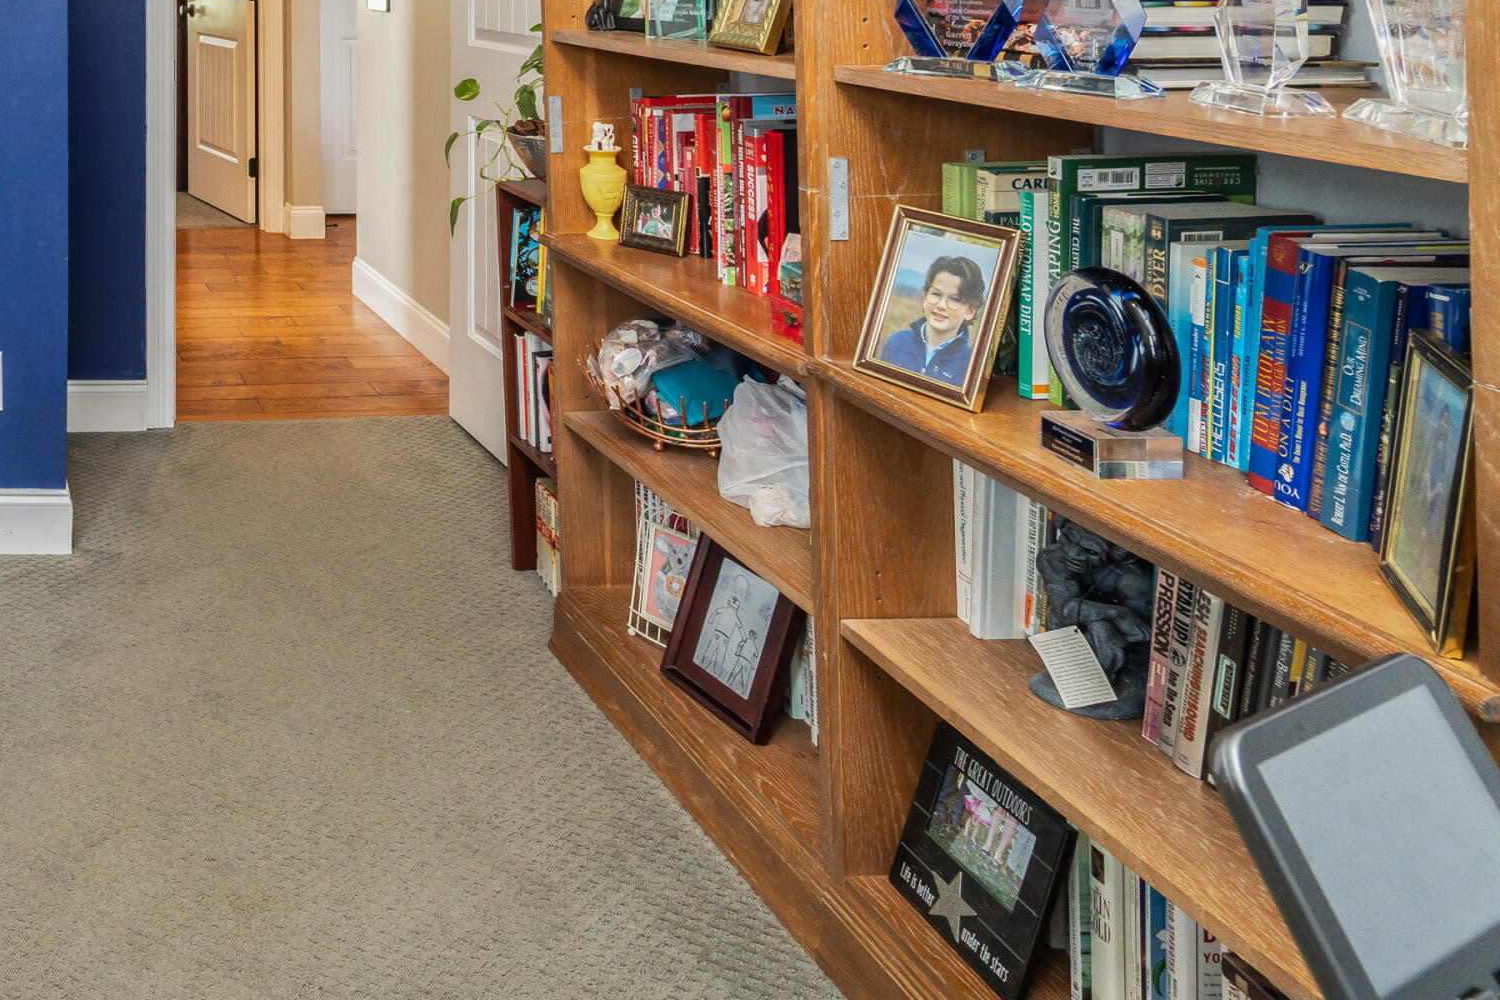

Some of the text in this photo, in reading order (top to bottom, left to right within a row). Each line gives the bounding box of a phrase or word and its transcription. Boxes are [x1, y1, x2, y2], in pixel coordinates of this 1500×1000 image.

[946, 31, 972, 39] Garrett
[747, 164, 755, 220] SUCCESS
[1071, 218, 1080, 270] THE CELESTI
[1021, 249, 1031, 302] FODMAP
[1152, 248, 1166, 299] DYER
[1020, 304, 1031, 335] DIET
[1191, 327, 1199, 352] Leader
[1273, 318, 1287, 379] GENERATION
[1342, 357, 1355, 376] OUR
[1231, 353, 1240, 388] NEXT!
[1253, 314, 1276, 445] TOM BROKAW
[1324, 365, 1336, 401] AMERICA
[1349, 334, 1368, 406] DREAMING MIND
[1212, 361, 1225, 427] CLOSERS
[1270, 379, 1283, 429] GREATEST
[1283, 375, 1295, 412] DIET
[1278, 436, 1289, 459] ON
[959, 490, 967, 518] Physical
[1275, 479, 1301, 499] YOU
[1309, 476, 1324, 513] STEPHEN
[1028, 509, 1037, 545] RELUCTANT
[1331, 502, 1346, 526] ROBERT
[960, 519, 968, 564] Degeneration
[1153, 571, 1175, 658] PRESSION
[1163, 579, 1194, 728] RTAN UP! Joe De Sena
[1183, 592, 1212, 742] ESH SEARCHING SOUND
[1273, 662, 1289, 688] Brain
[954, 746, 1033, 827] THE GREAT OUTDOORS
[917, 884, 935, 908] better
[961, 928, 981, 953] under
[990, 952, 1009, 983] stars
